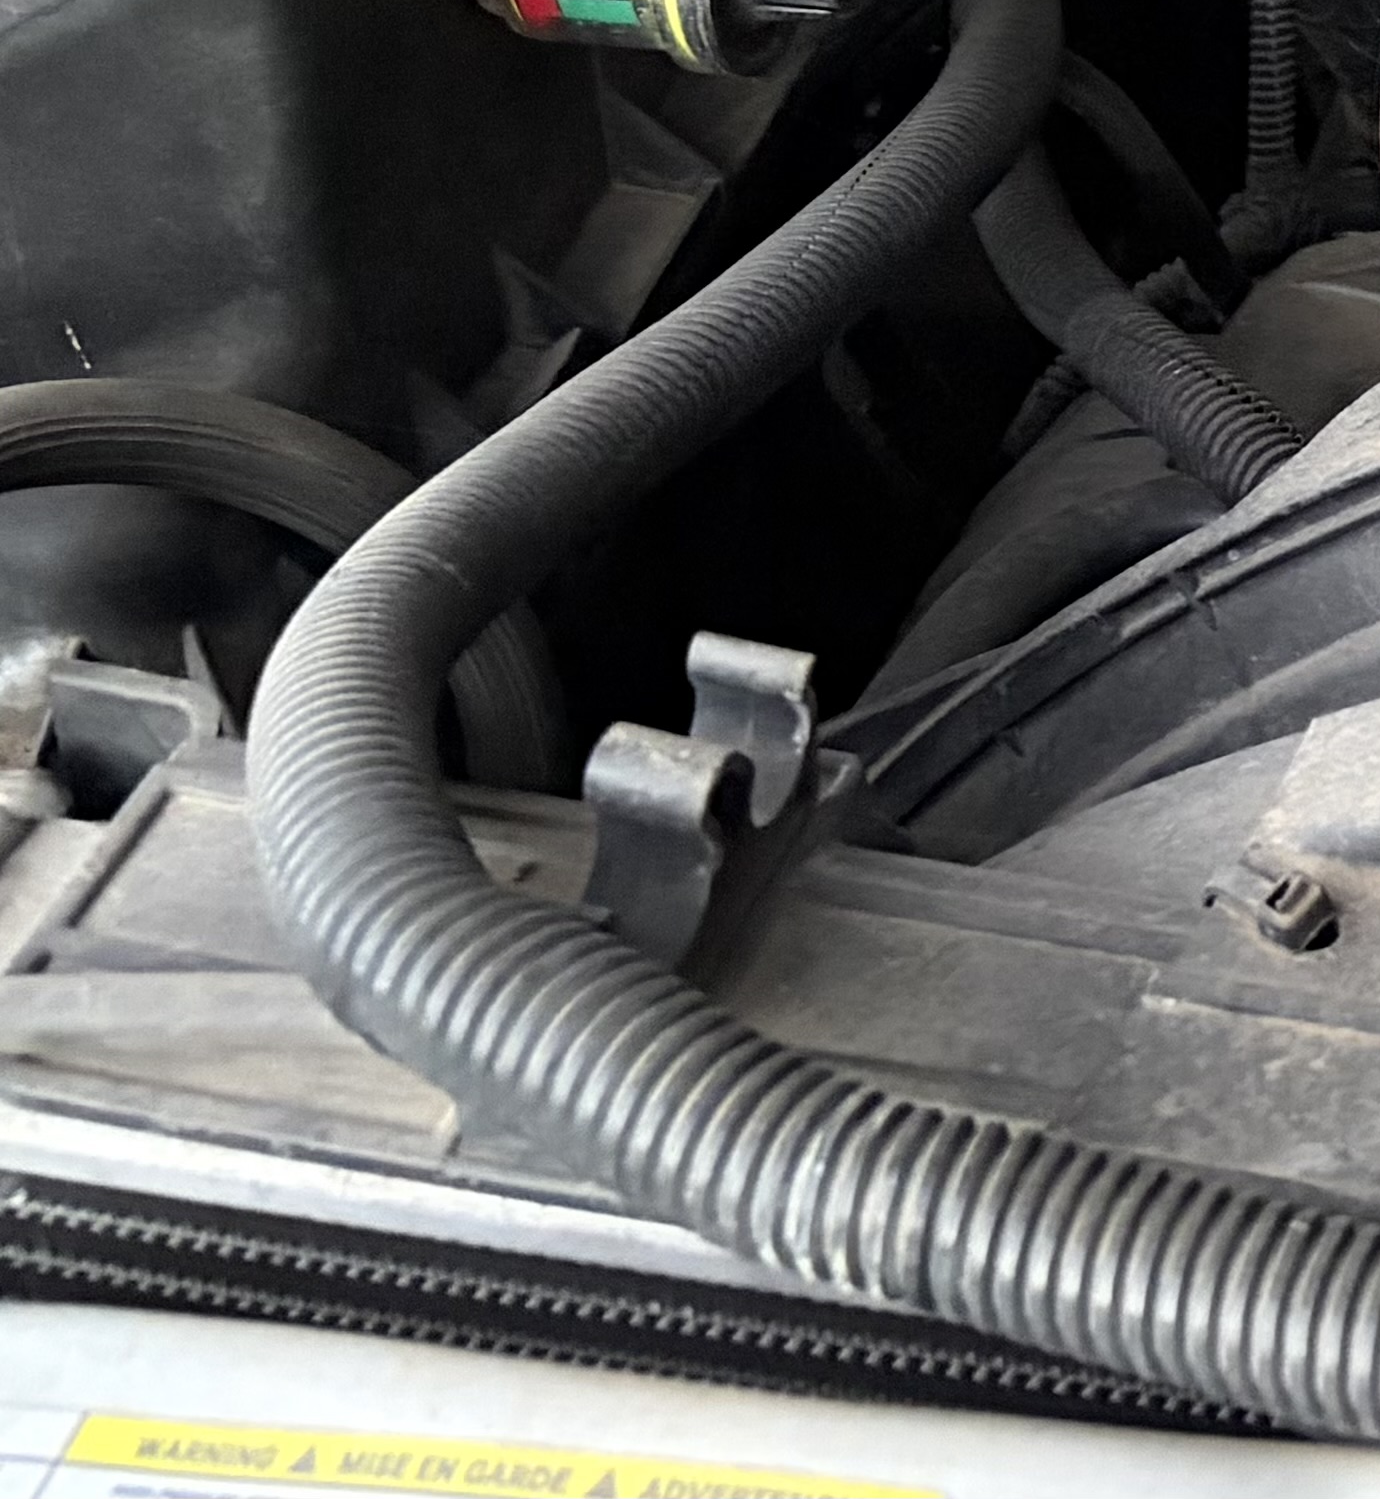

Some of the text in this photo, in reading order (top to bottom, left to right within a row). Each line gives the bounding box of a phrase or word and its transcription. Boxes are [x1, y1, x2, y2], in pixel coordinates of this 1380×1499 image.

[135, 1436, 280, 1471] WARNING
[336, 1449, 414, 1479] MISE
[416, 1454, 460, 1483] EN
[463, 1457, 576, 1494] GARDE
